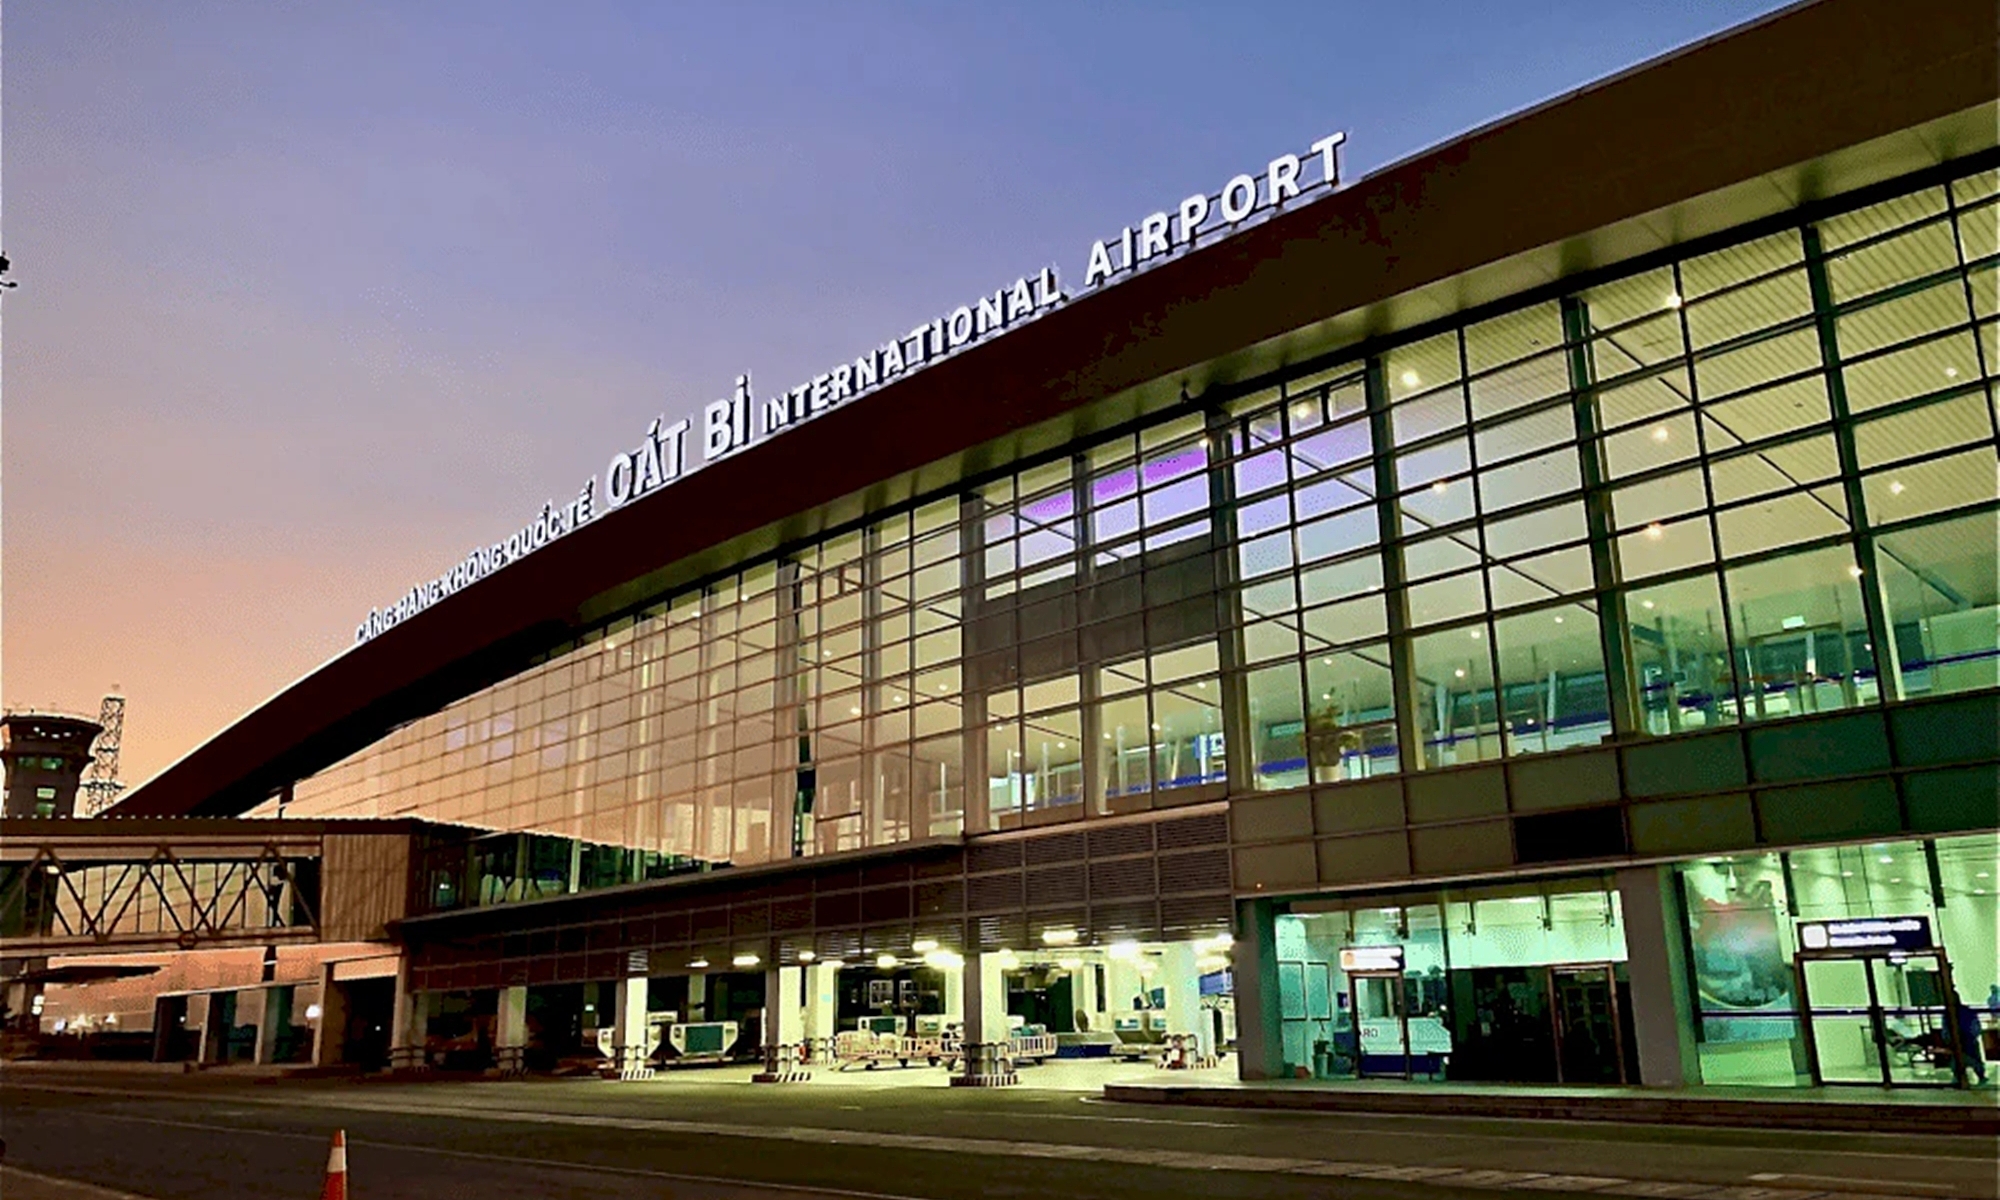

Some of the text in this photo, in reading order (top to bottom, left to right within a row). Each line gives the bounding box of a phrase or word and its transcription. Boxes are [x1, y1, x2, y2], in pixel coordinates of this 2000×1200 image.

[508, 500, 562, 563] QUỐC
[605, 417, 690, 504] CÁT
[762, 266, 1063, 434] INTERNATIONAL
[1084, 131, 1347, 286] AIRPORT
